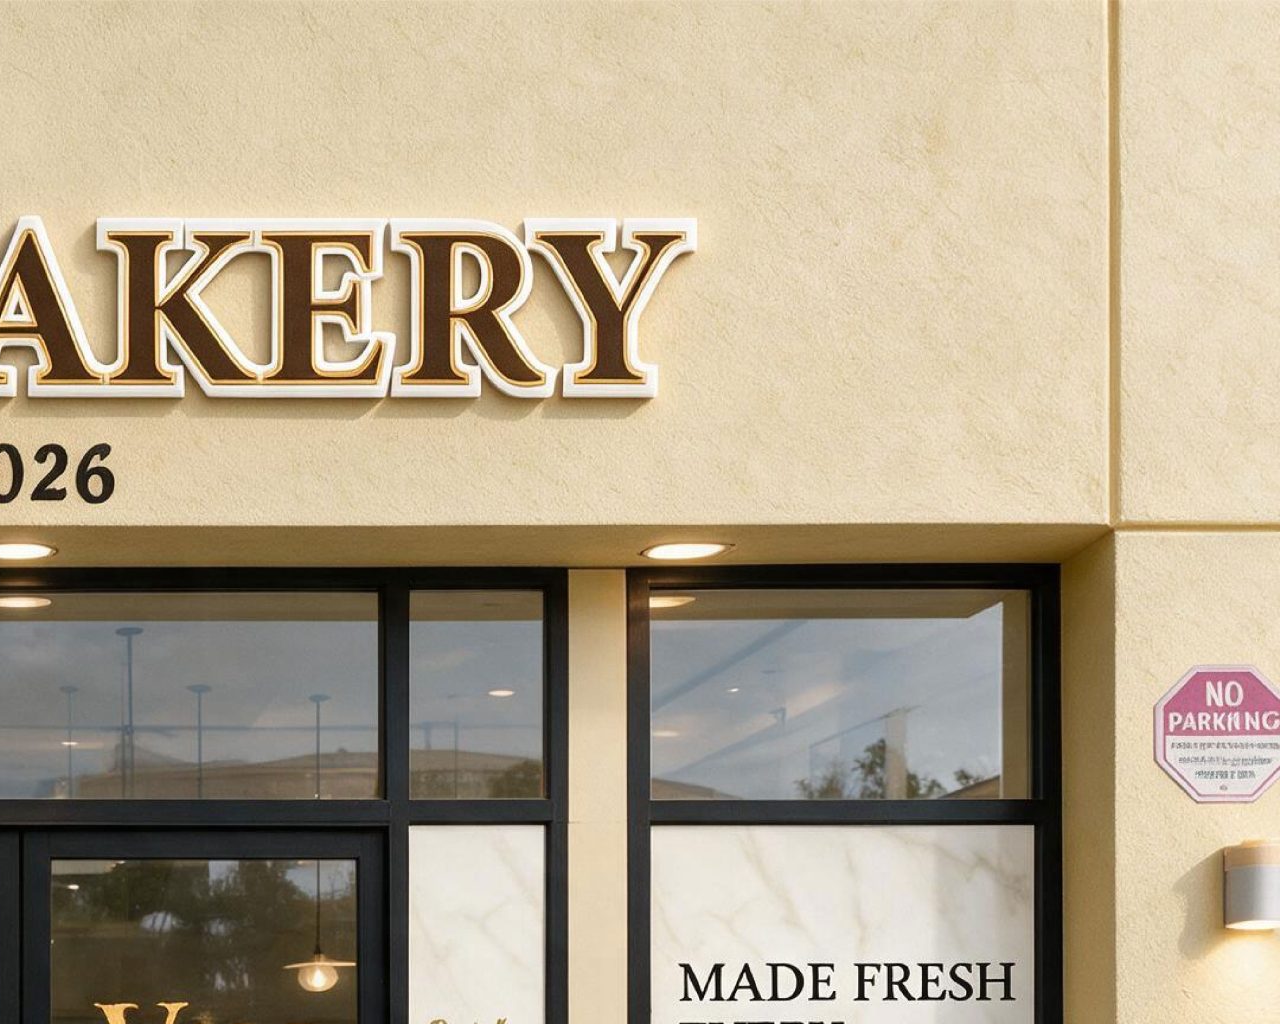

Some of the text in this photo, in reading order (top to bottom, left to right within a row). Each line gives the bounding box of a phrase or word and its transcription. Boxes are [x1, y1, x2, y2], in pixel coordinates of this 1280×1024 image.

[1205, 680, 1244, 708] NO
[678, 962, 1016, 1001] MADE FRESH
